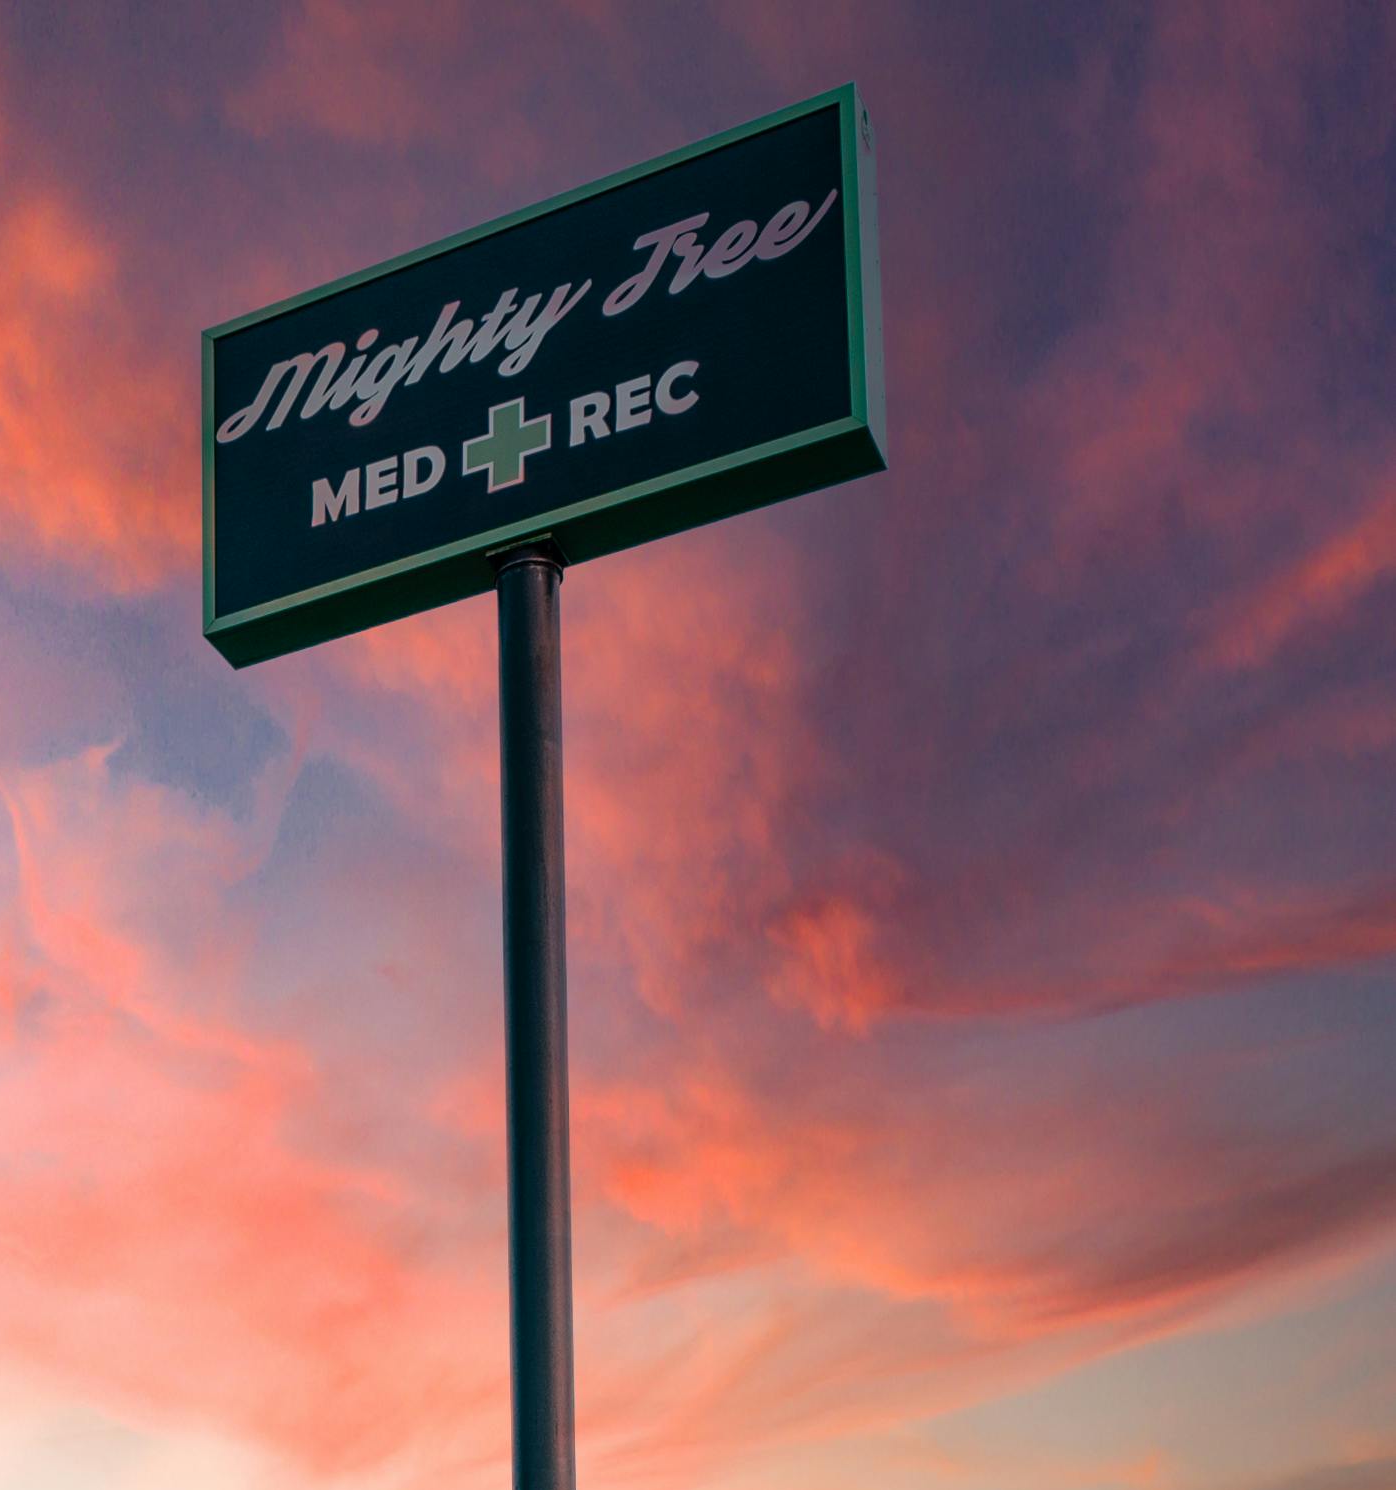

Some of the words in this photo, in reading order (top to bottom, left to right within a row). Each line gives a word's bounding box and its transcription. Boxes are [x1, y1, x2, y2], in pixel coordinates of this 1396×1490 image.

[216, 278, 592, 443] Mighty
[602, 189, 838, 317] Tree
[310, 444, 447, 528] MED
[568, 360, 700, 449] REC
